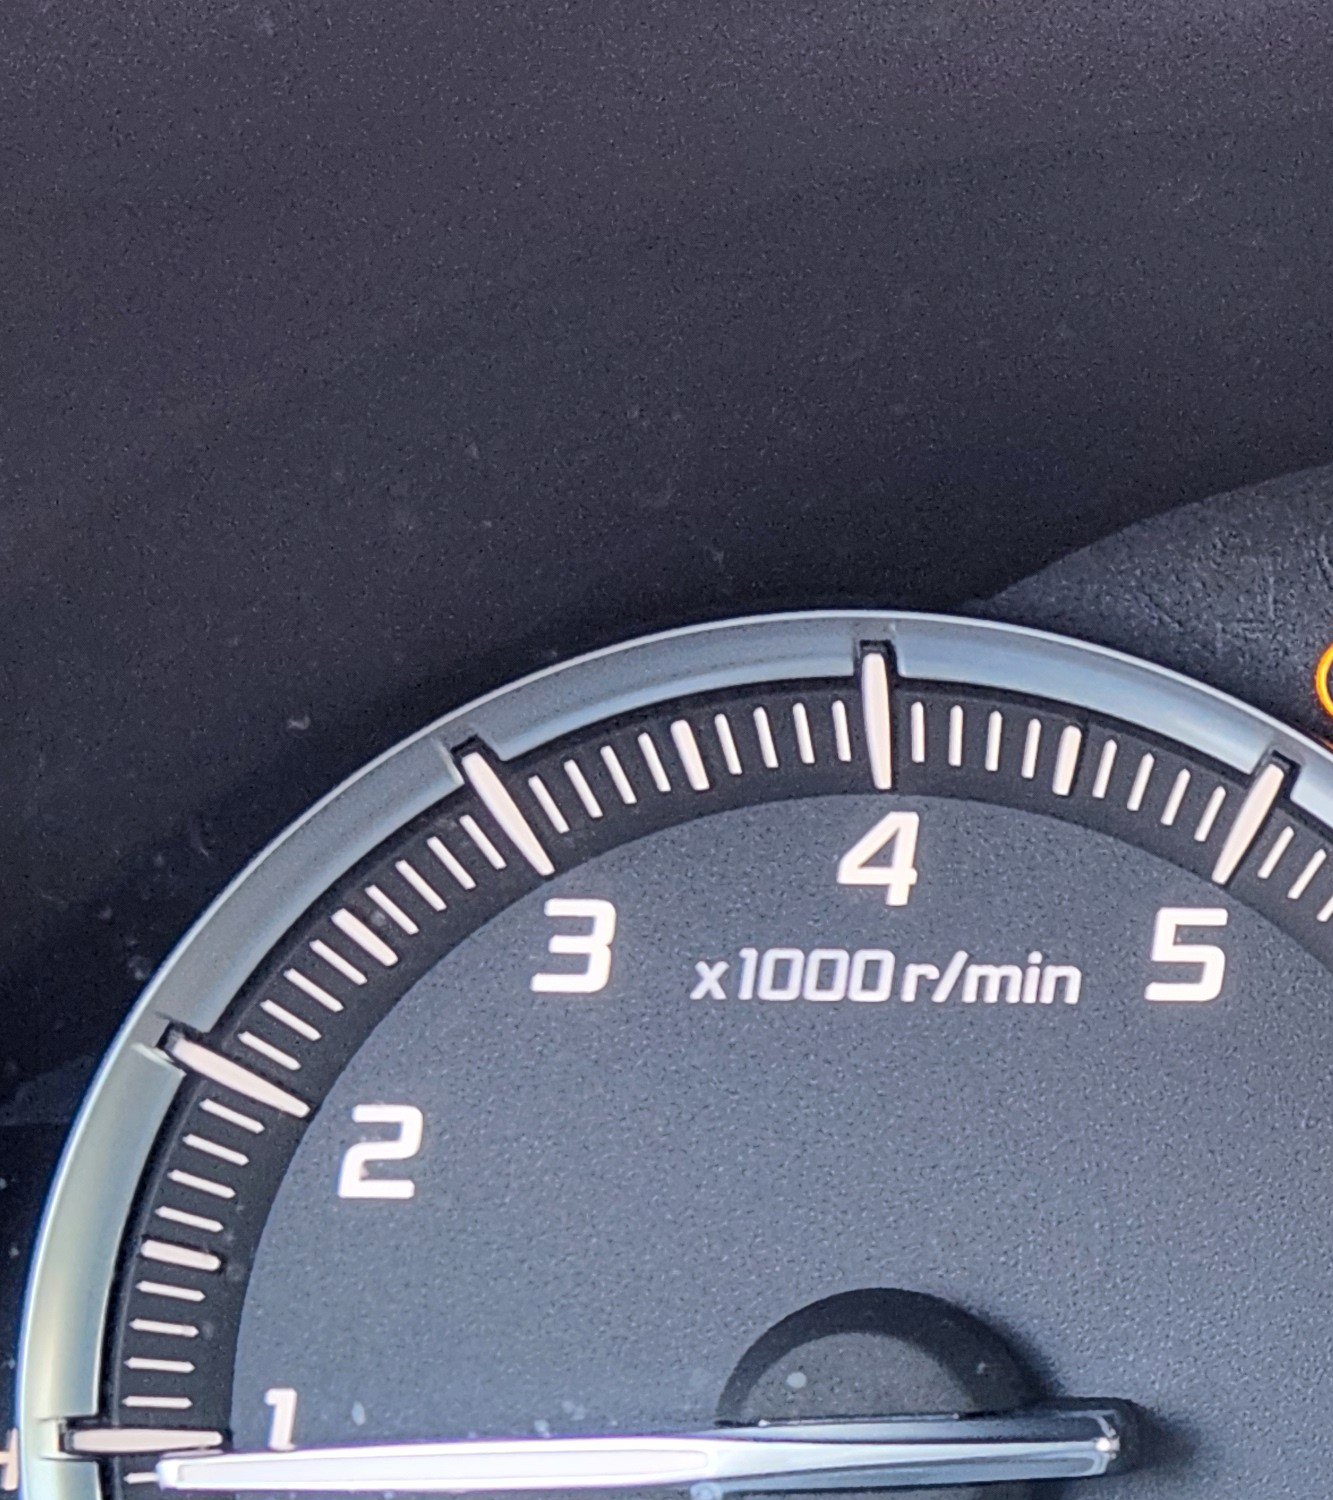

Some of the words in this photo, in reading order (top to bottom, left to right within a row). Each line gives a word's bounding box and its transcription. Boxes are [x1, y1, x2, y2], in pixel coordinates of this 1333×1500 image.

[835, 810, 921, 907] 4
[530, 897, 618, 994] 3
[1143, 906, 1229, 1003] 5
[337, 1103, 424, 1200] 2
[263, 1387, 299, 1451] 1
